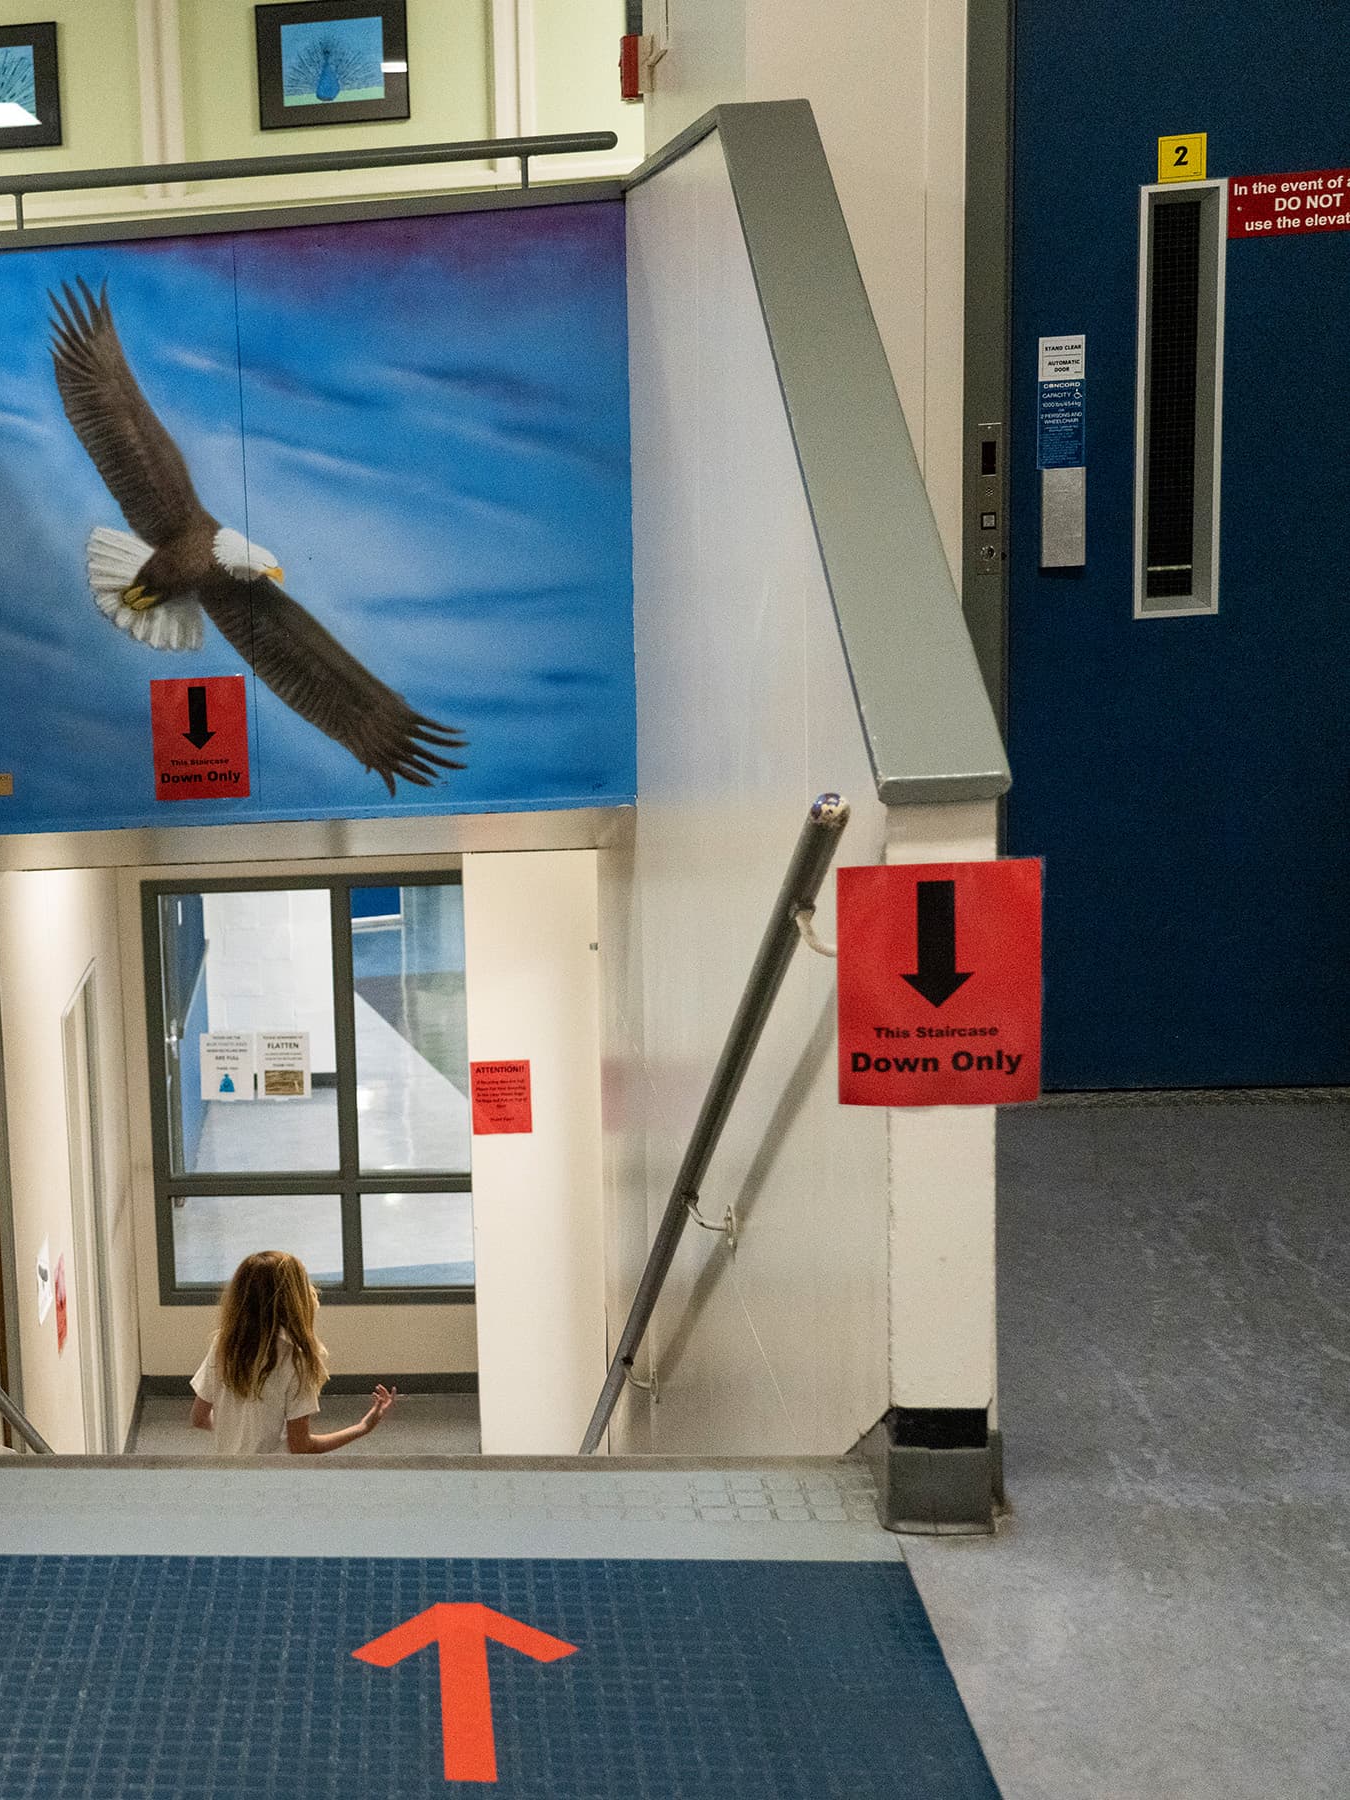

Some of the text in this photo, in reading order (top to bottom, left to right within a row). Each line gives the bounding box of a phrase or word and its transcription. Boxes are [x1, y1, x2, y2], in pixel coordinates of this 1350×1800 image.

[1173, 146, 1189, 167] 2
[1234, 183, 1248, 196] In
[1253, 182, 1277, 195] the
[1281, 177, 1323, 193] event
[1327, 175, 1345, 189] of
[1274, 193, 1345, 212] DO NOT
[1245, 219, 1273, 232] use
[1277, 216, 1301, 229] the
[190, 758, 229, 766] Staircase
[161, 770, 241, 784] Down Only
[874, 1025, 999, 1038] This Staircase
[851, 1049, 1023, 1076] Down Only
